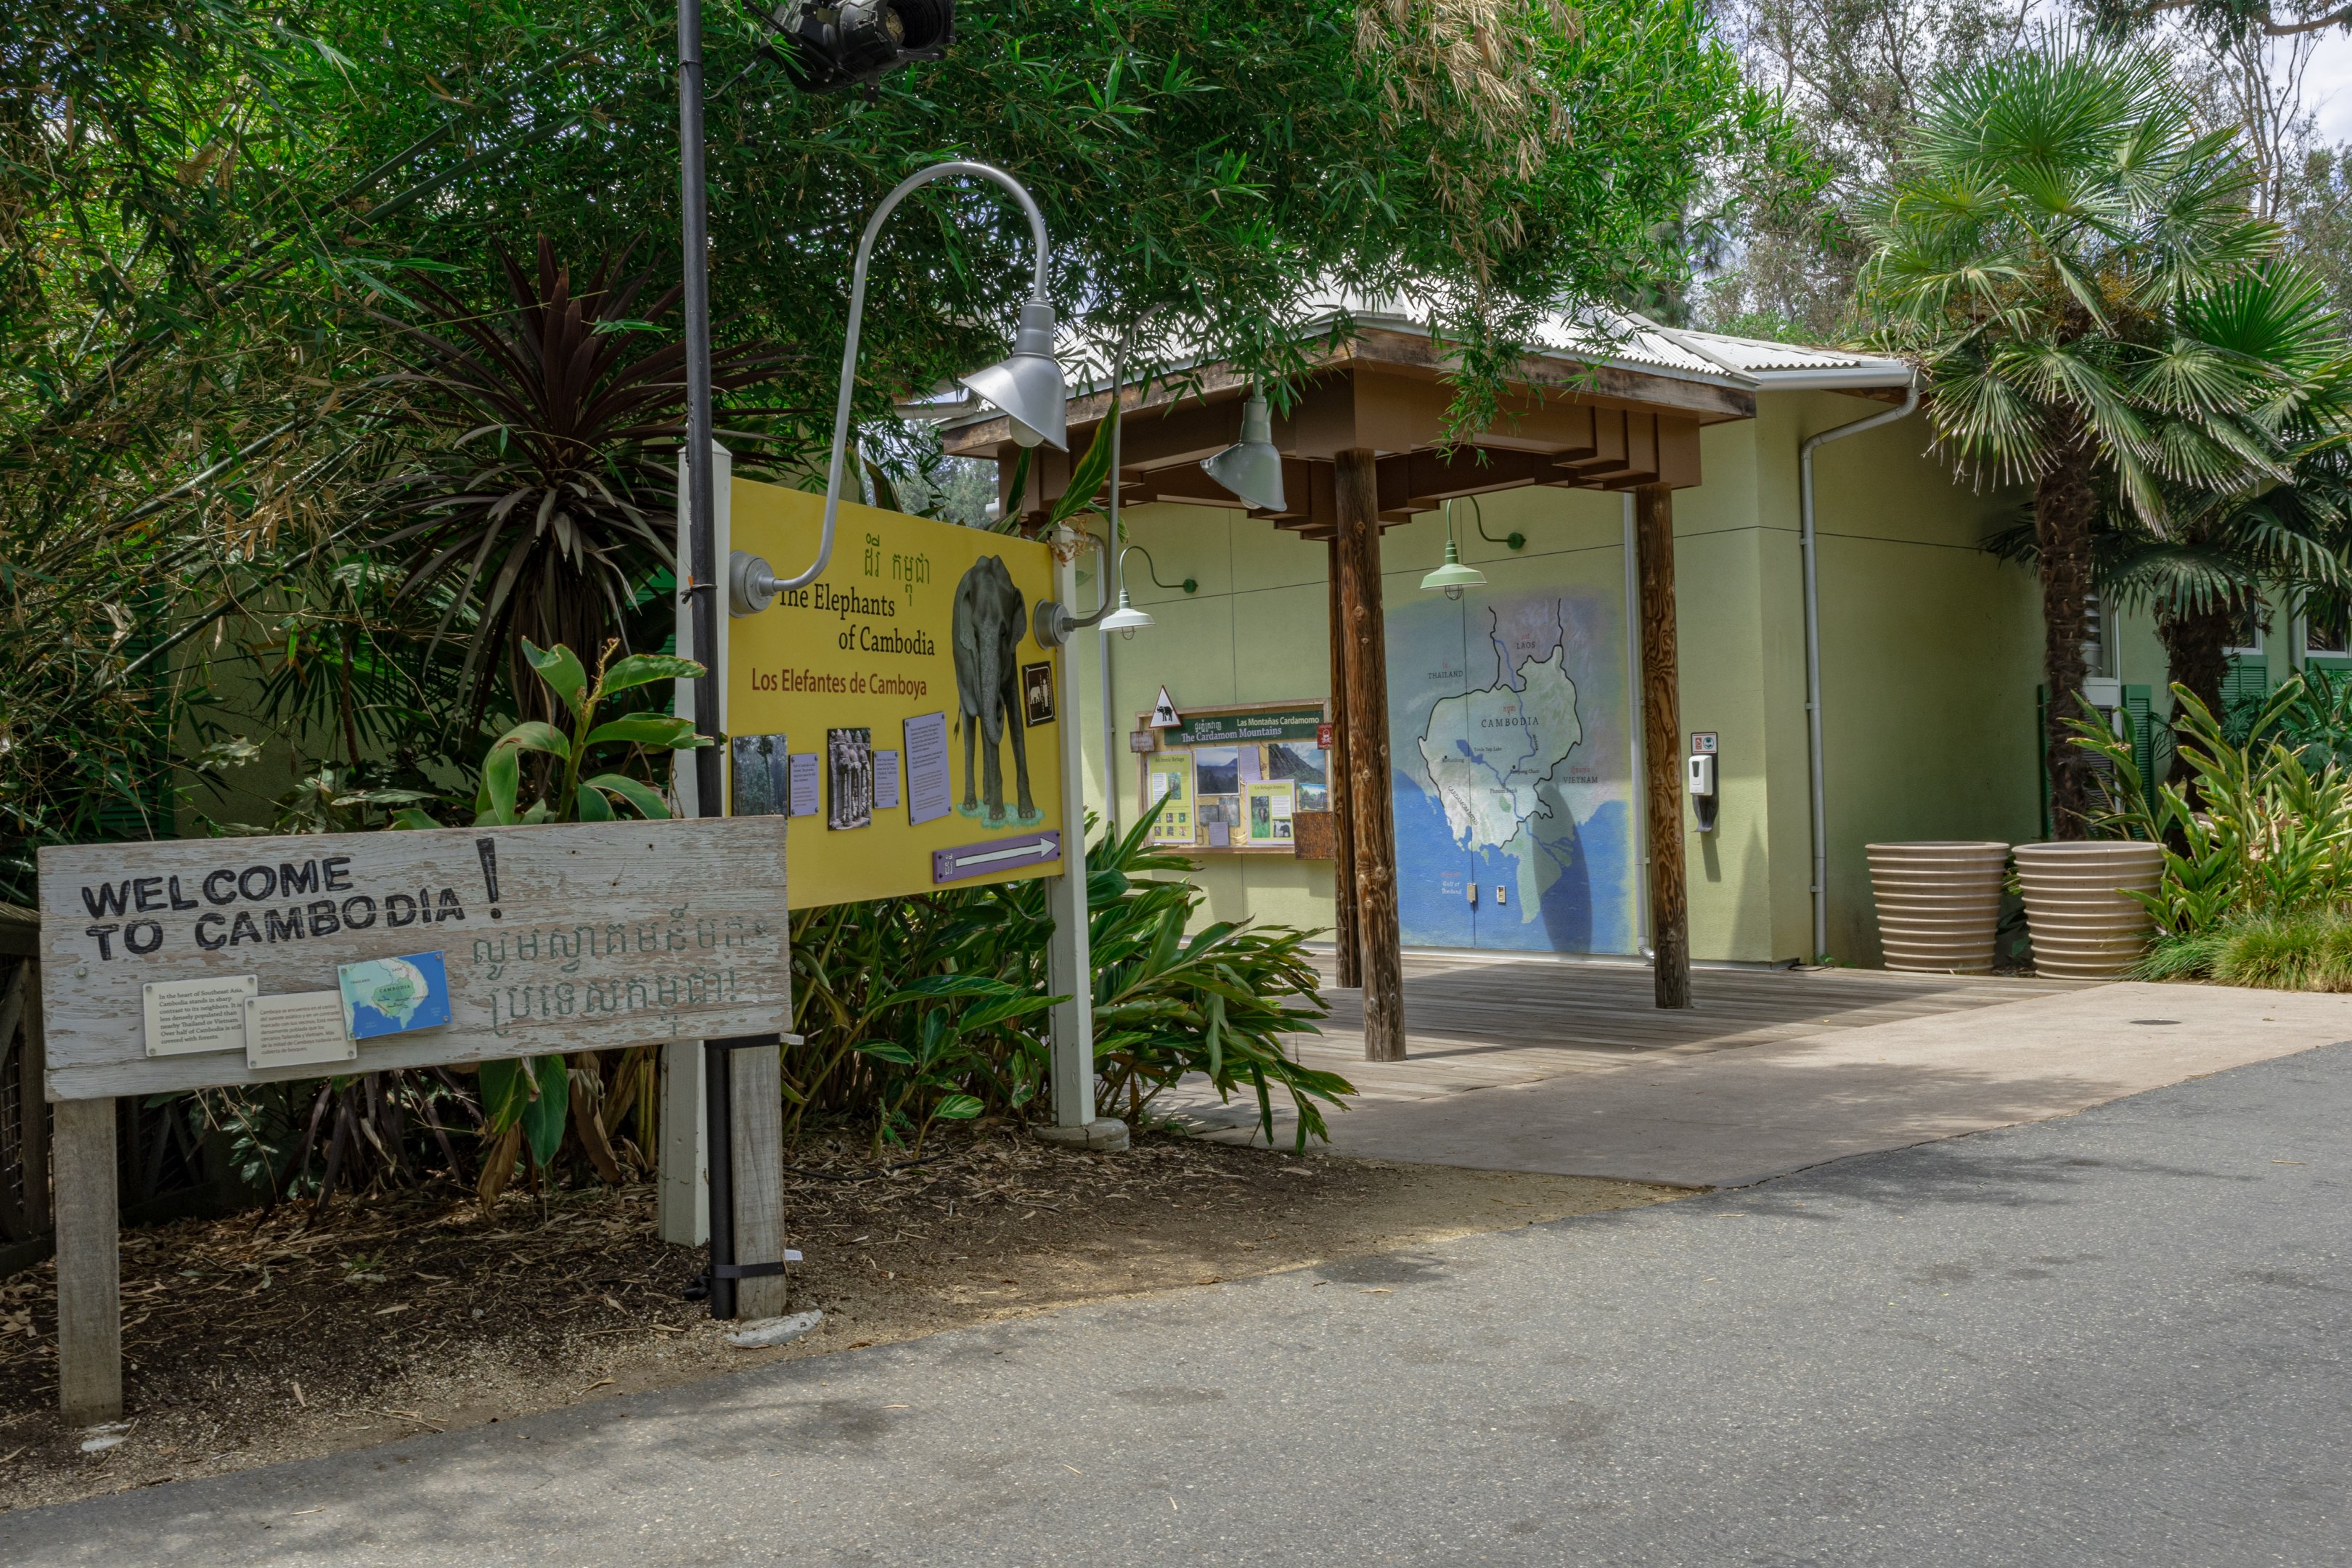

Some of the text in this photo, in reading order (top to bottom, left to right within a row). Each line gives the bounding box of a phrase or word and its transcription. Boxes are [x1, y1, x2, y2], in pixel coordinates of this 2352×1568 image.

[814, 583, 895, 620] Elephants
[839, 624, 935, 656] of Cambodia
[752, 668, 927, 701] Los Elefantes de Camboya
[1428, 670, 1463, 679] THAILAND
[1181, 726, 1282, 743] The Cardamom Mountains
[1249, 717, 1279, 726] Montañas
[1279, 716, 1320, 725] Cardamomo
[1481, 716, 1540, 728] CAMBODIA
[81, 856, 354, 920] WELCOME
[85, 919, 164, 962] TO
